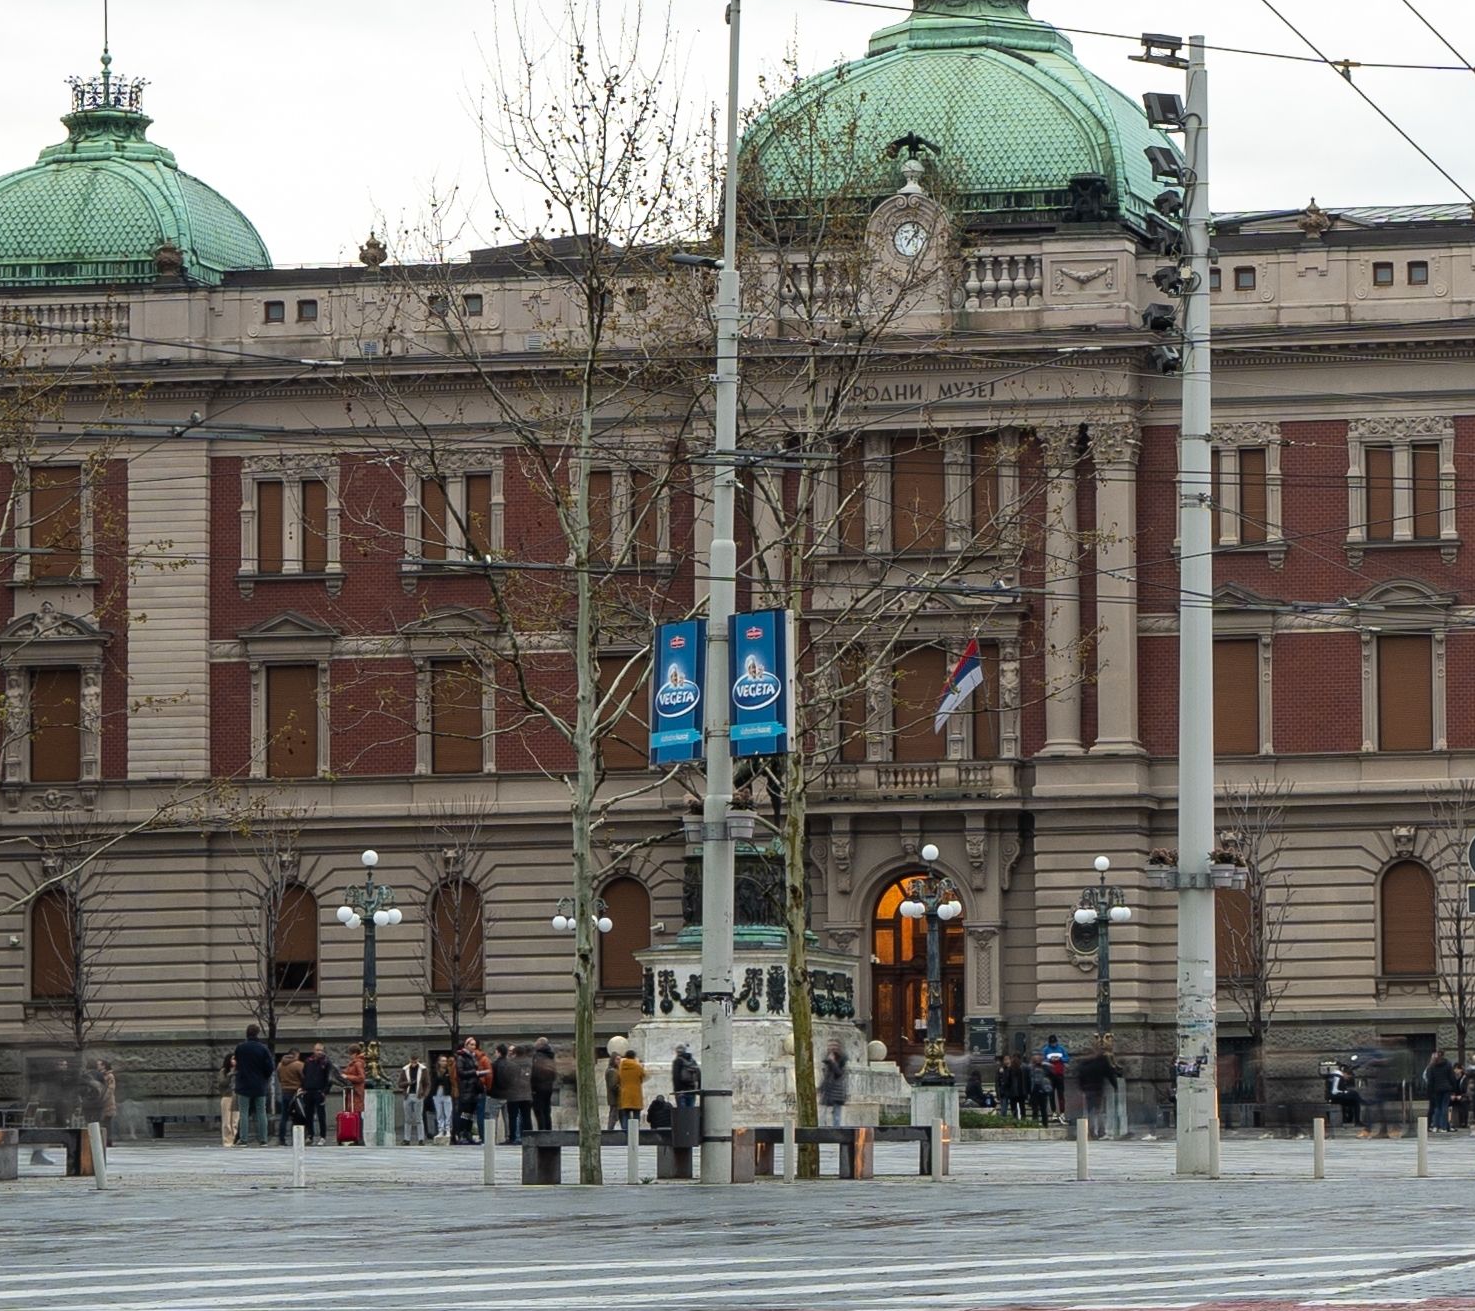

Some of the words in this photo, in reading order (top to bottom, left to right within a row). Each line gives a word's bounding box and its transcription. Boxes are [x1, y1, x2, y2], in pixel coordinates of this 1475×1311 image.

[824, 384, 922, 403] НРОДНИ
[938, 381, 995, 399] МУЗЕЈ
[737, 683, 775, 697] VEGETA
[659, 691, 694, 705] VEGETA
